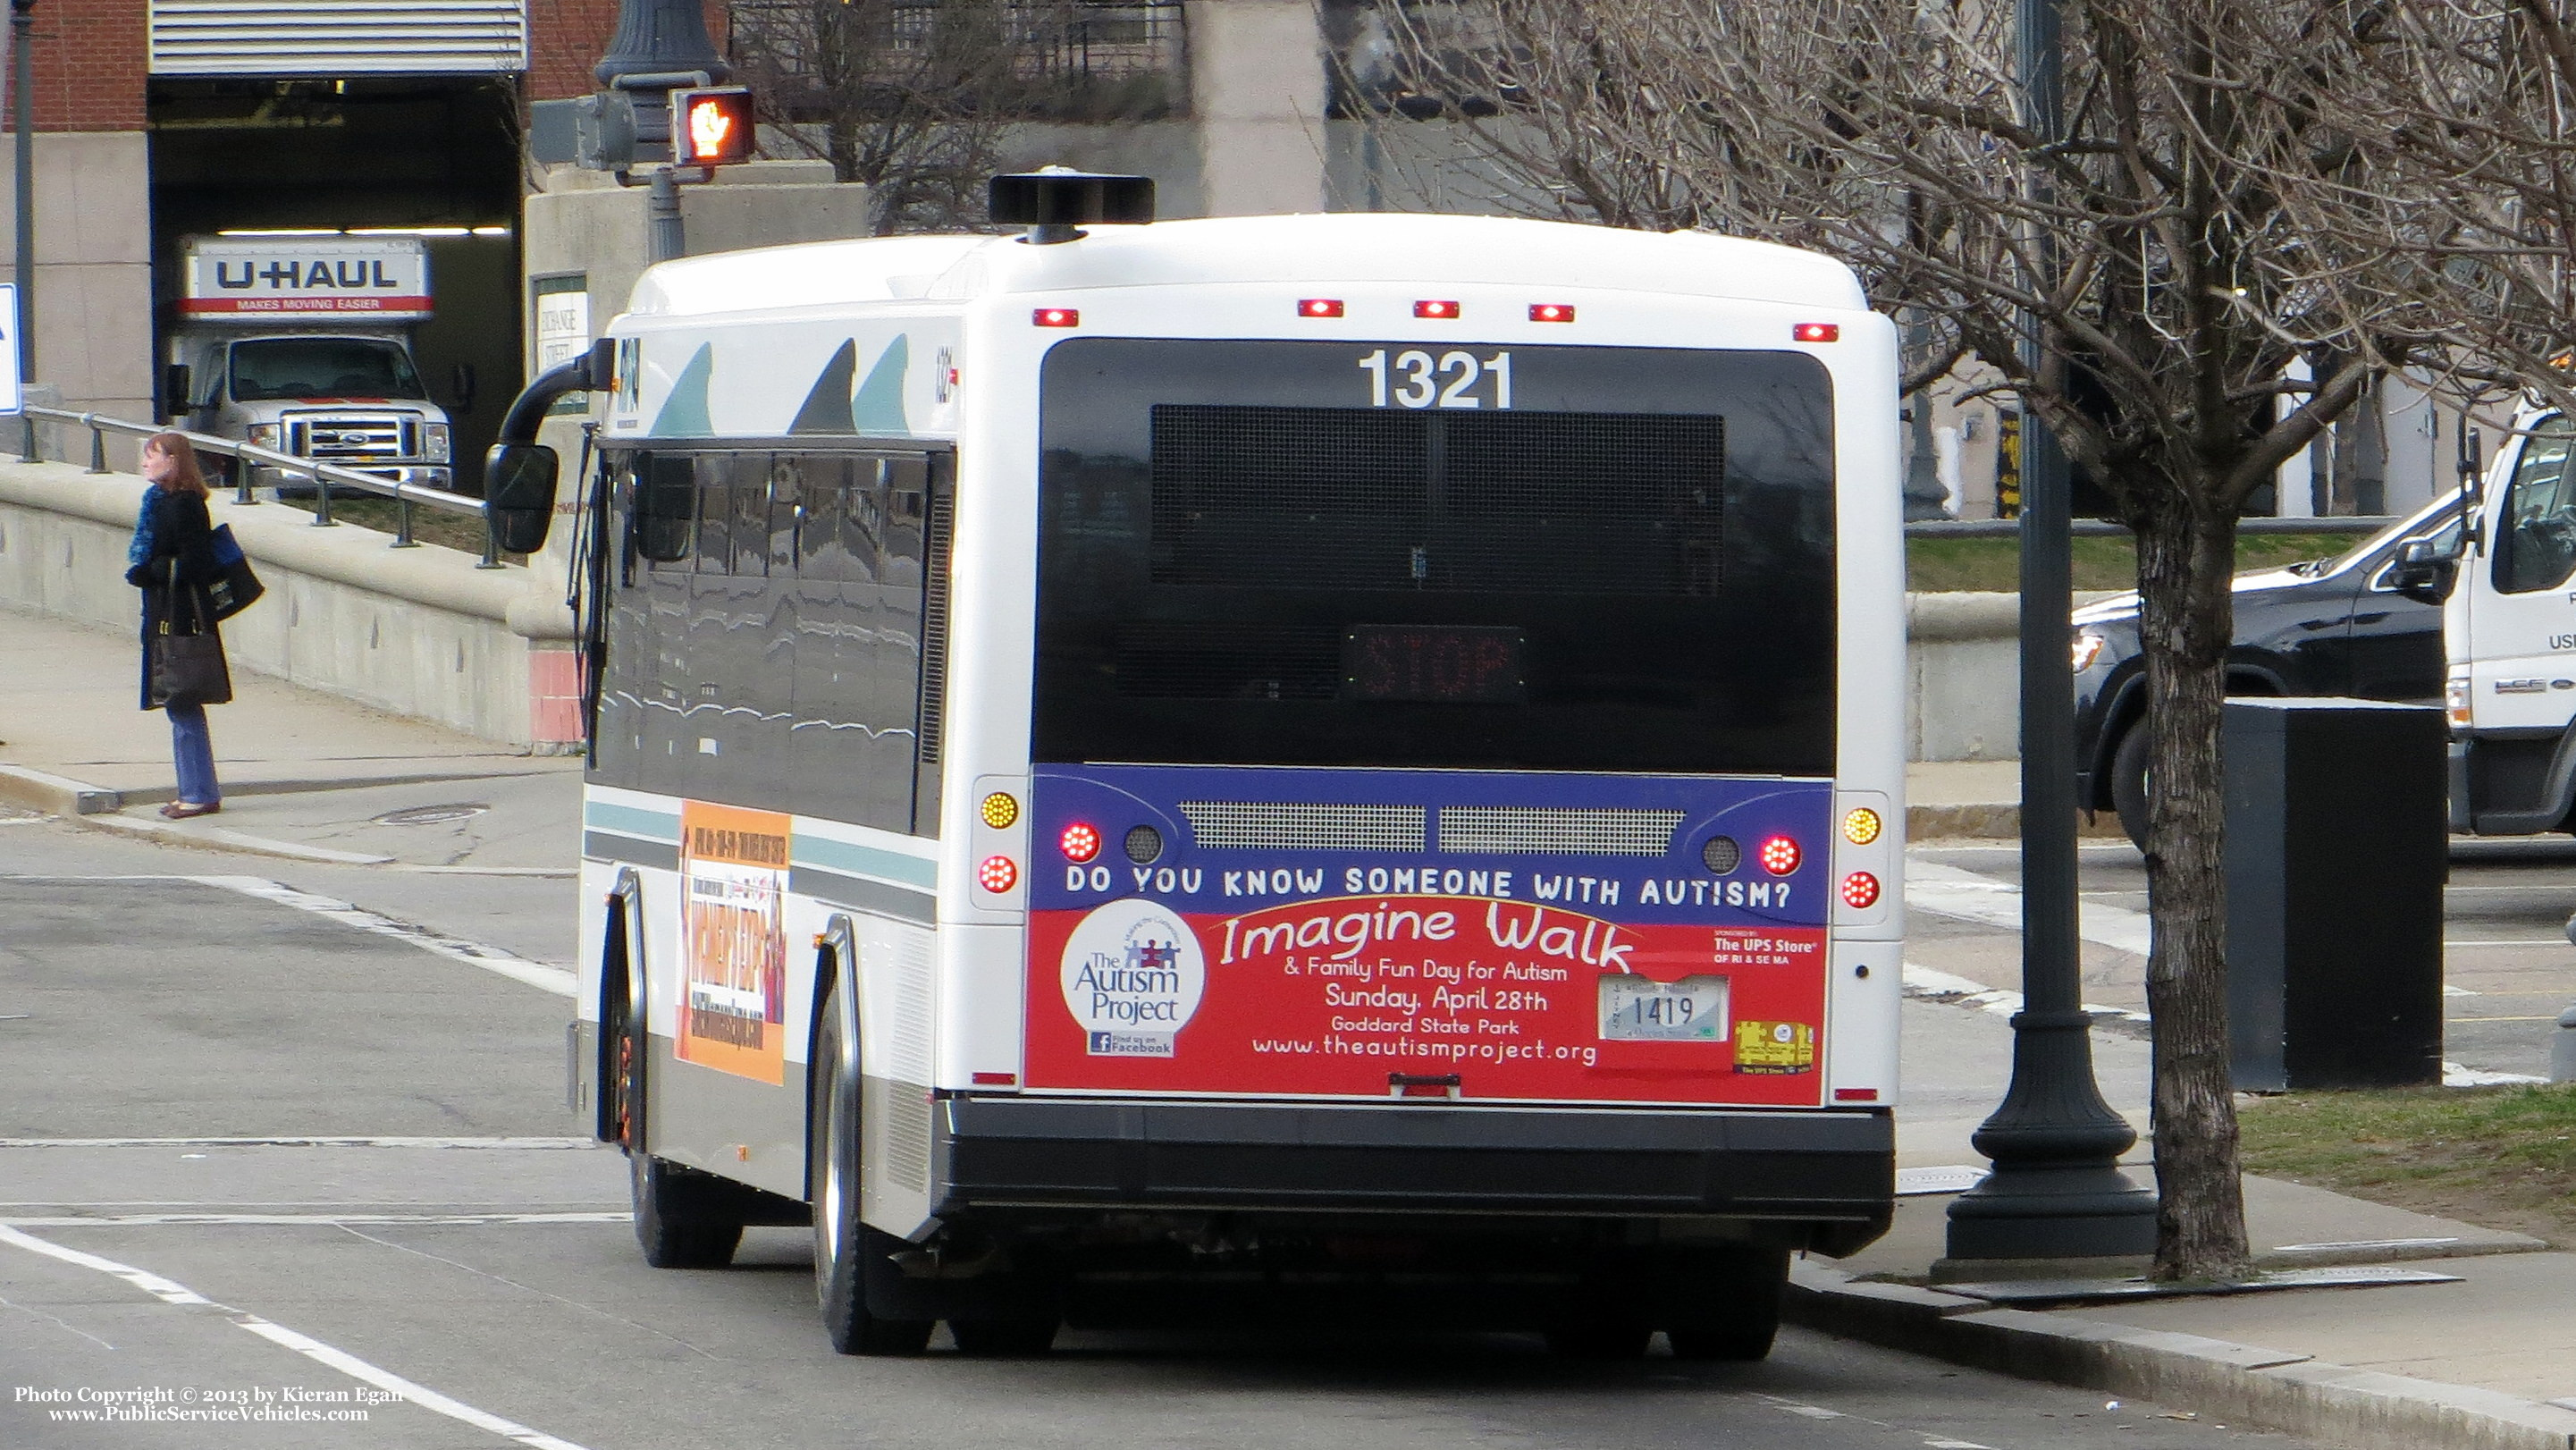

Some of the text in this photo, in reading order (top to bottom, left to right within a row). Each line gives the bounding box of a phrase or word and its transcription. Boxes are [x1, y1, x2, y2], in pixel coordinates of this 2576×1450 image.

[216, 260, 398, 289] U-HAUL
[237, 299, 380, 311] MAKES MOVING EASIER
[1359, 349, 1511, 409] 1321
[2548, 633, 2576, 650] US
[1366, 635, 1509, 694] STOP
[1066, 865, 1791, 909] DO YOU KNOW SOMEONE WITH AUTISM?
[1220, 900, 1635, 974] Imagine Walk
[1714, 937, 1739, 951] The
[1743, 938, 1772, 952] UPS
[1091, 952, 1121, 969] The
[1284, 957, 1568, 985] & Family Fun Day for Autism
[1713, 954, 1789, 965] OF RI & SE MA
[1073, 960, 1180, 993] Autism
[1092, 992, 1179, 1026] Project
[1432, 990, 1490, 1020] April
[1494, 990, 1548, 1011] 28th
[1635, 997, 1693, 1024] 1419
[1331, 1016, 1520, 1035] Goddard State Park
[1112, 1042, 1171, 1053] Facebook
[1252, 1037, 1596, 1066] www.theautismproject.org
